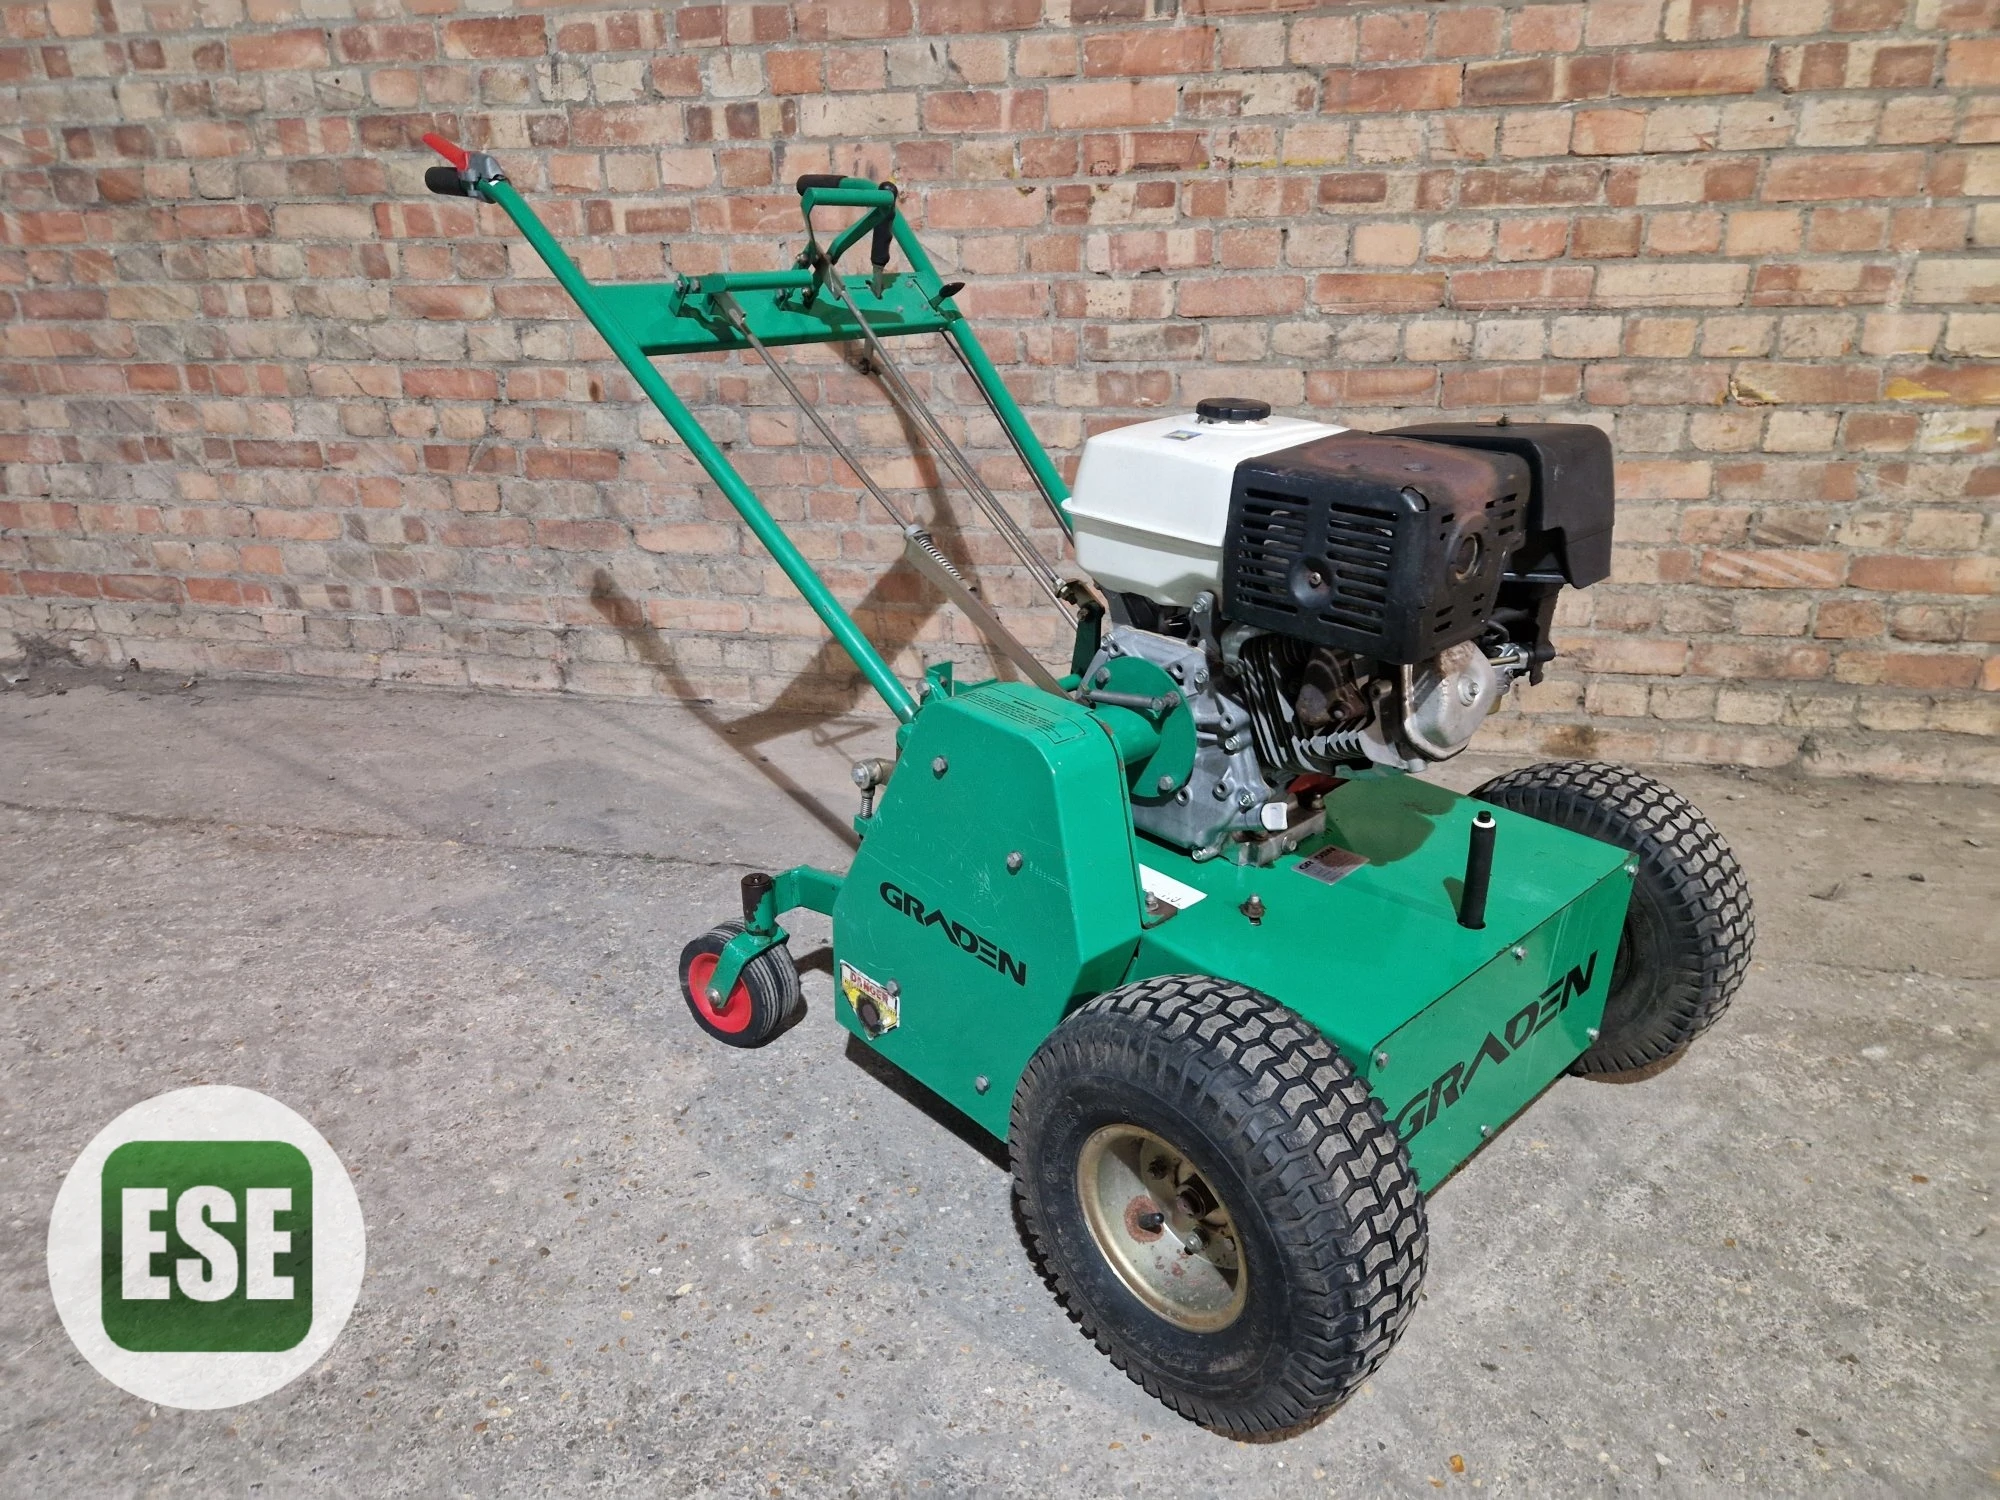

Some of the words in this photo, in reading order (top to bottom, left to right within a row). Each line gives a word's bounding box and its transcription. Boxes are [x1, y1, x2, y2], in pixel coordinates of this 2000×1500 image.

[1299, 846, 1336, 870] GRDEN
[880, 882, 1026, 987] GRADEN
[850, 971, 889, 1006] DANGER
[1395, 950, 1598, 1144] GRADEN
